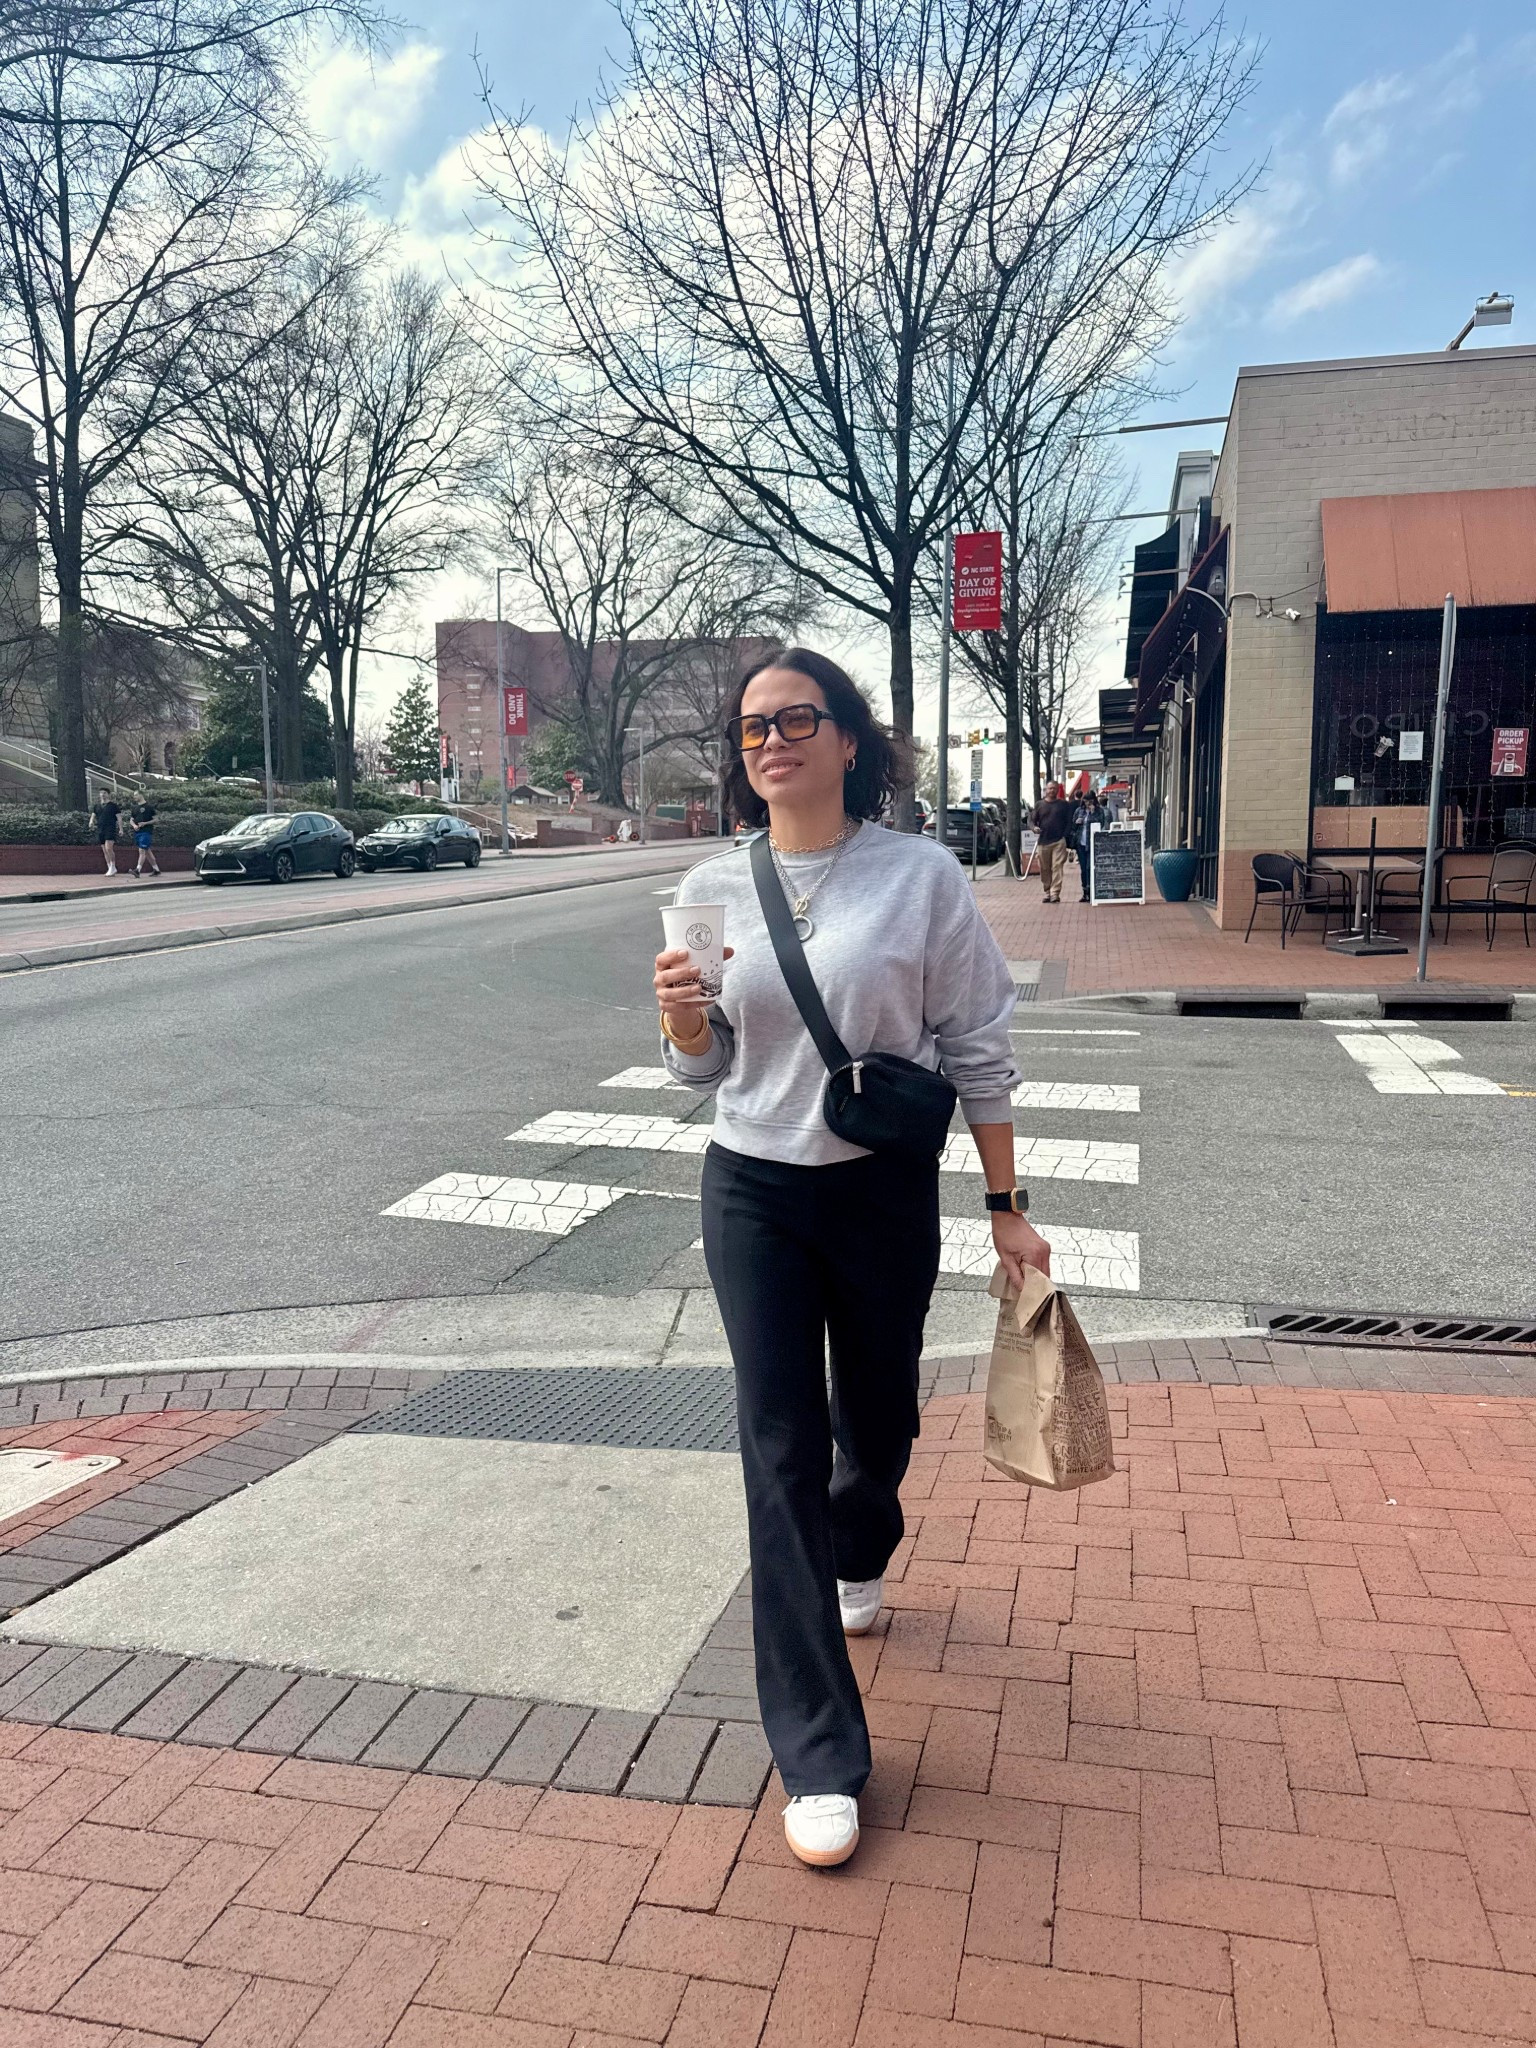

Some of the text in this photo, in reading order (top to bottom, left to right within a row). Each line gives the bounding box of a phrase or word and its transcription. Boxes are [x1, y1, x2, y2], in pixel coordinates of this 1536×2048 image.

[959, 576, 997, 588] DAY OF
[959, 587, 997, 598] GIVING
[508, 693, 516, 725] AND DO
[516, 693, 524, 719] THINK
[687, 924, 710, 936] CHIPOTLE
[1069, 1362, 1090, 1377] FLOUR
